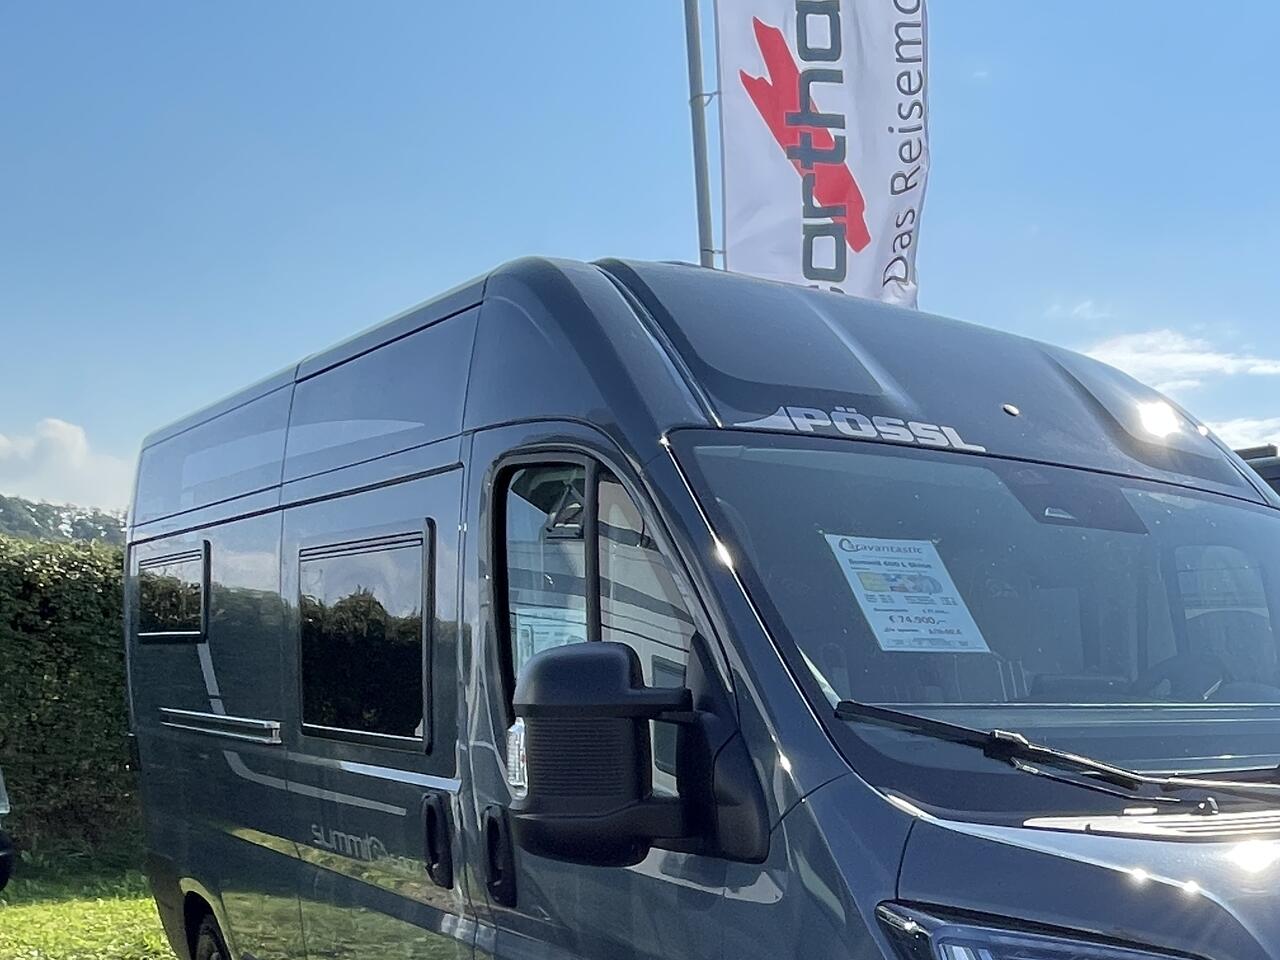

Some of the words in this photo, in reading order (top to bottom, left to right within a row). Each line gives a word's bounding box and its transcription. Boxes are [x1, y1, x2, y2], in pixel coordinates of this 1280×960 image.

[784, 0, 847, 294] artha
[883, 208, 915, 288] Das
[786, 406, 986, 452] PÖSSL
